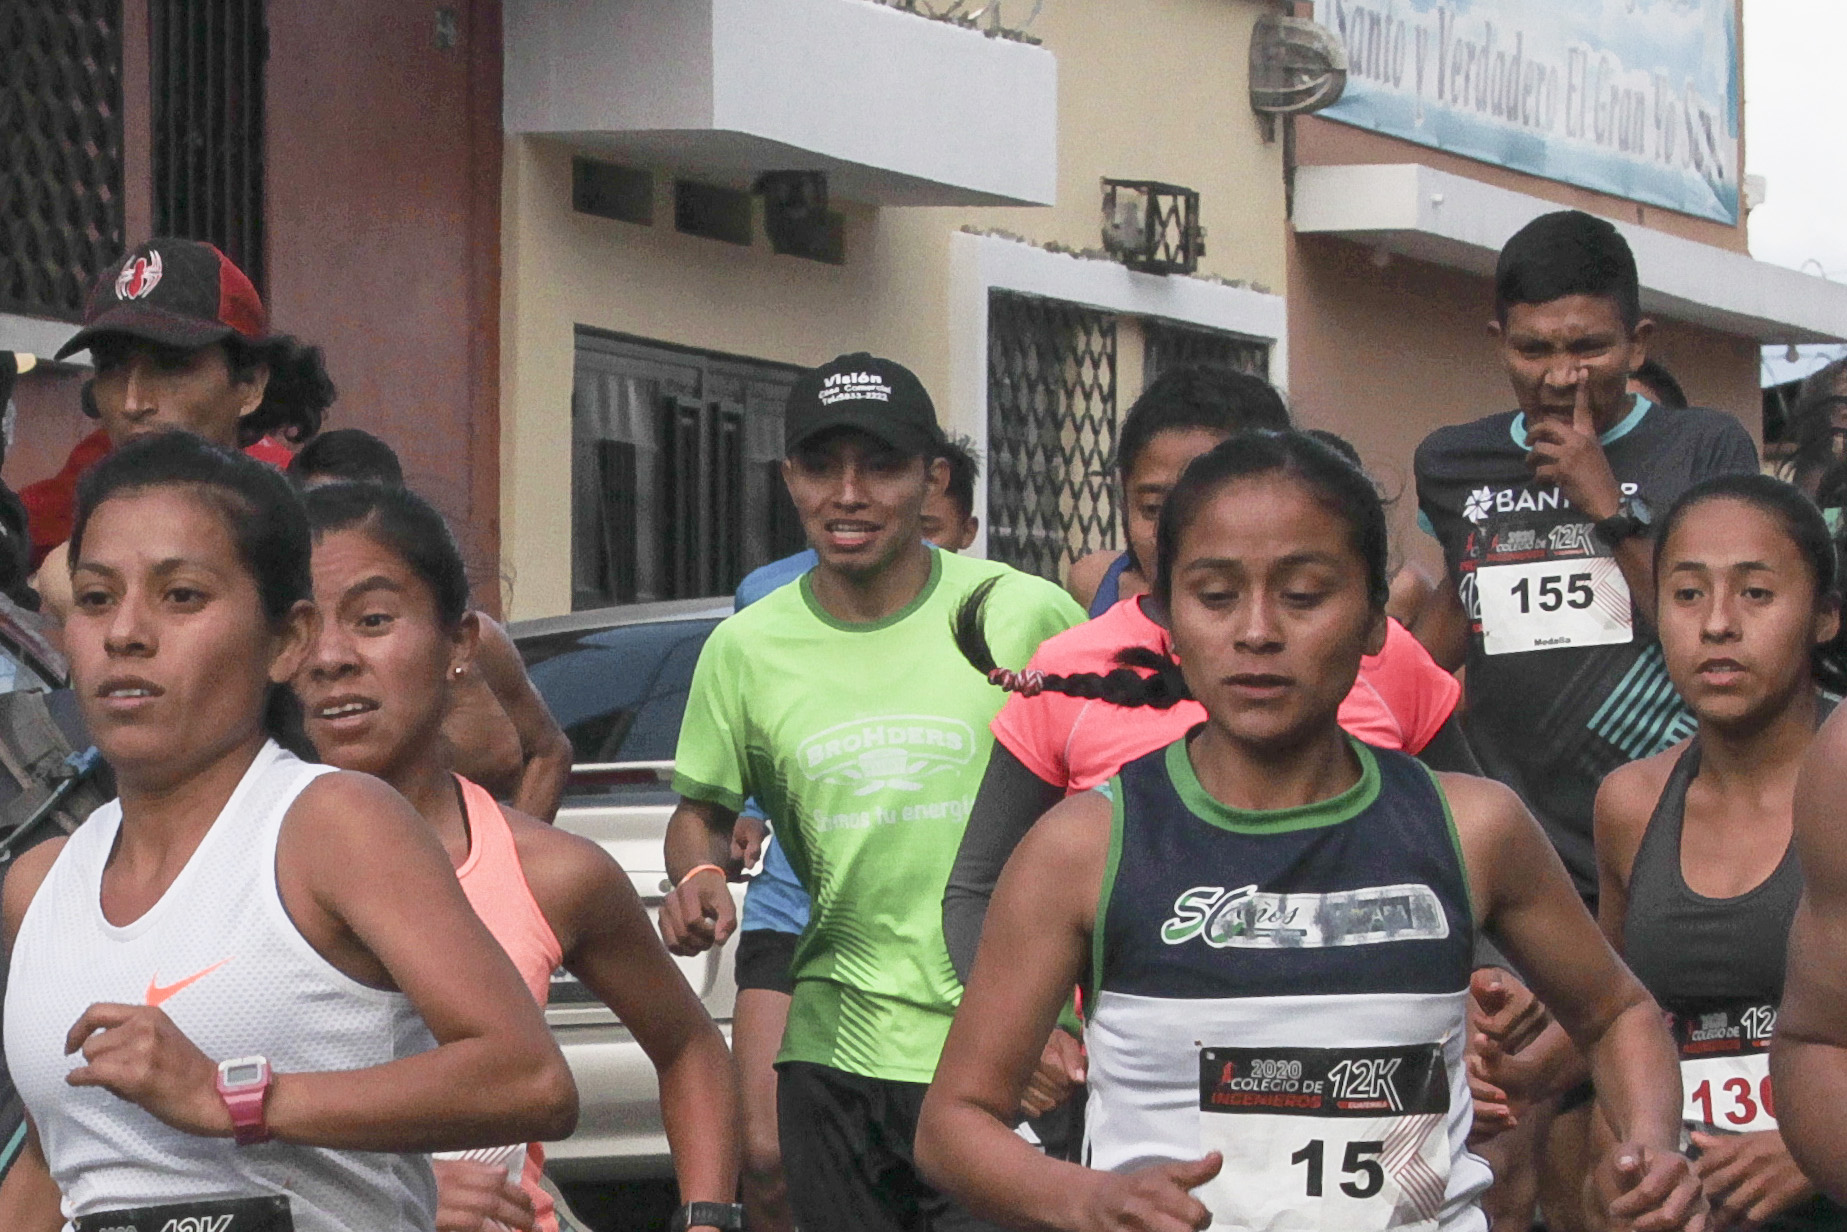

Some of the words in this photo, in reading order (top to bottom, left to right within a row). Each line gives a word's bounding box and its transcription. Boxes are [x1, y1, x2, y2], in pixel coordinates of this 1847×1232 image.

[1438, 5, 1557, 129] Verdadero
[824, 371, 883, 388] Visión
[1548, 523, 1596, 556] 12K
[1511, 572, 1594, 614] 155
[1740, 1004, 1778, 1040] 12
[1230, 1077, 1299, 1092] COLEGIO
[1302, 1079, 1324, 1094] DE
[1250, 1058, 1302, 1080] 2020
[1327, 1057, 1404, 1112] 12K
[1292, 1139, 1384, 1199] 15
